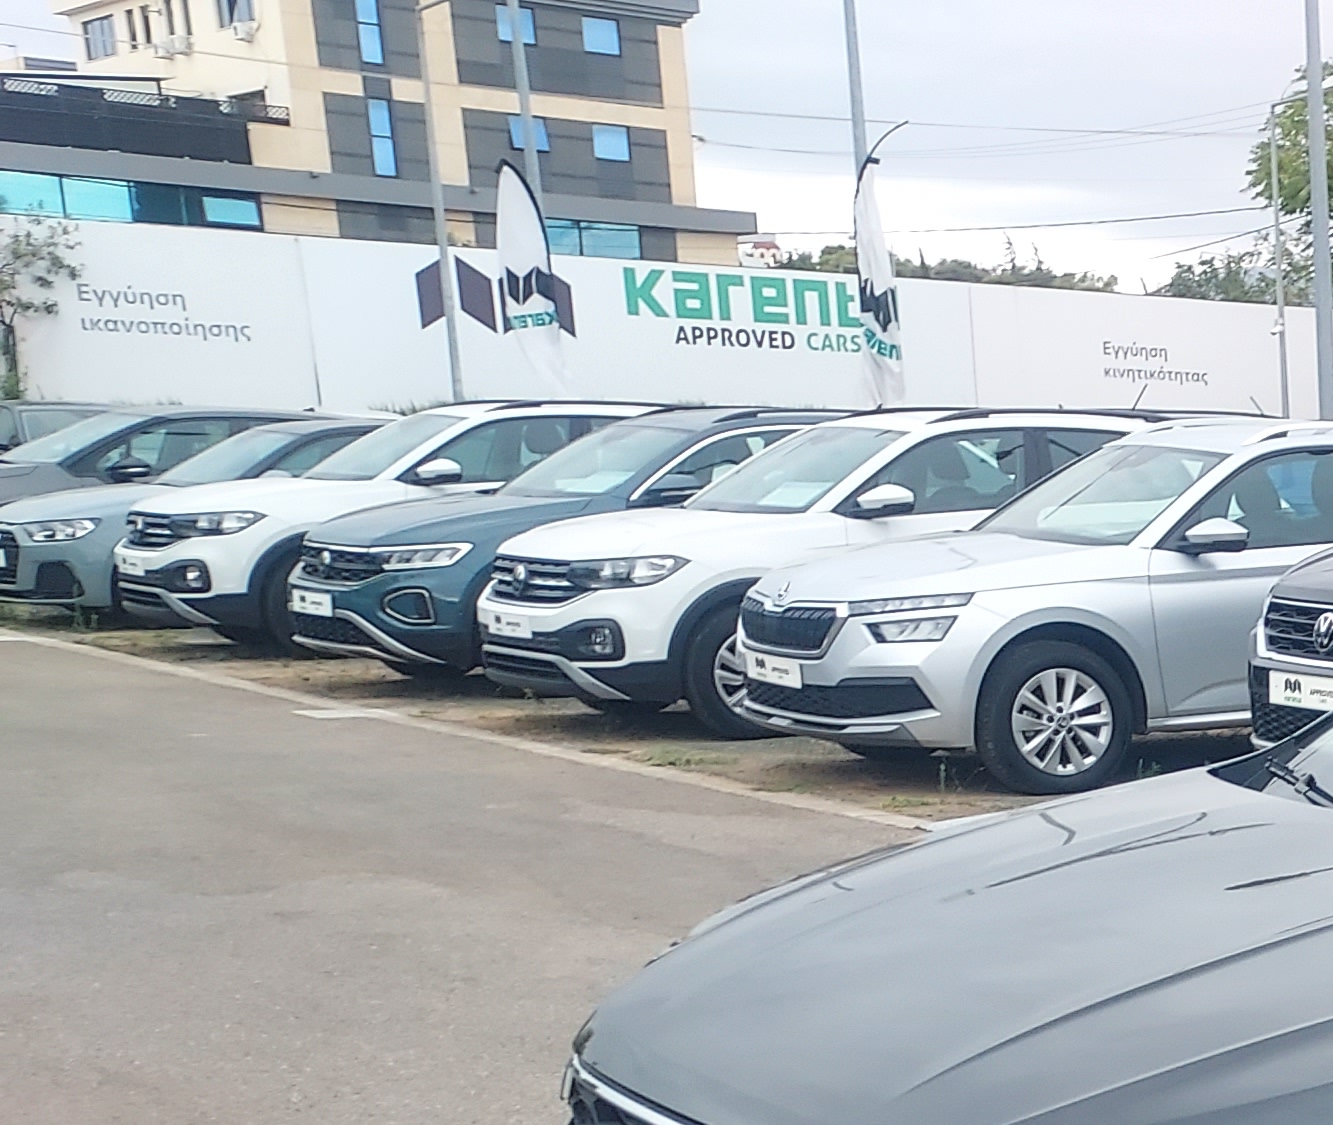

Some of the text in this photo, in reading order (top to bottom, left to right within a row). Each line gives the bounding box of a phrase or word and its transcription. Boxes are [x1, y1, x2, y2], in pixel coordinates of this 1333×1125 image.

[76, 283, 186, 312] Εγγύηση
[81, 317, 251, 342] ικανοποίησης
[675, 325, 861, 352] APPROVED CARS
[1103, 341, 1167, 362] Εγγύηση
[1104, 366, 1208, 386] κινητικότητας
